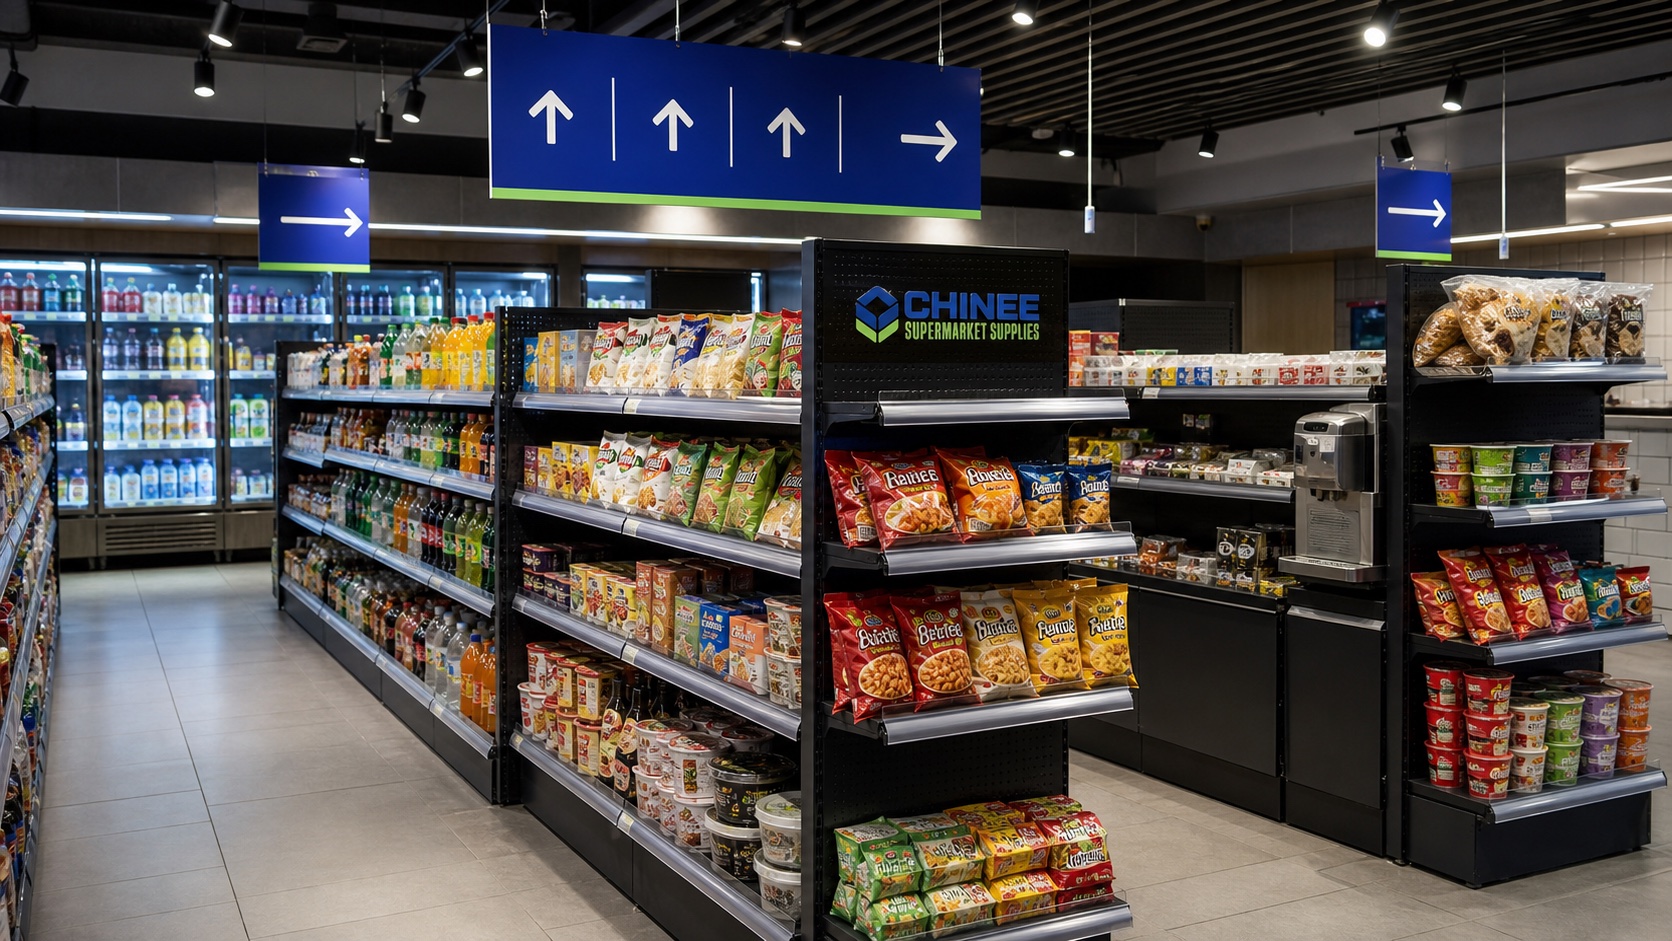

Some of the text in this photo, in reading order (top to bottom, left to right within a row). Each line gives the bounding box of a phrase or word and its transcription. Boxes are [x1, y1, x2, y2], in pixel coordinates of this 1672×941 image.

[904, 290, 1040, 321] CHINEE
[905, 321, 1040, 341] SUPERMARKET SUPPLIES
